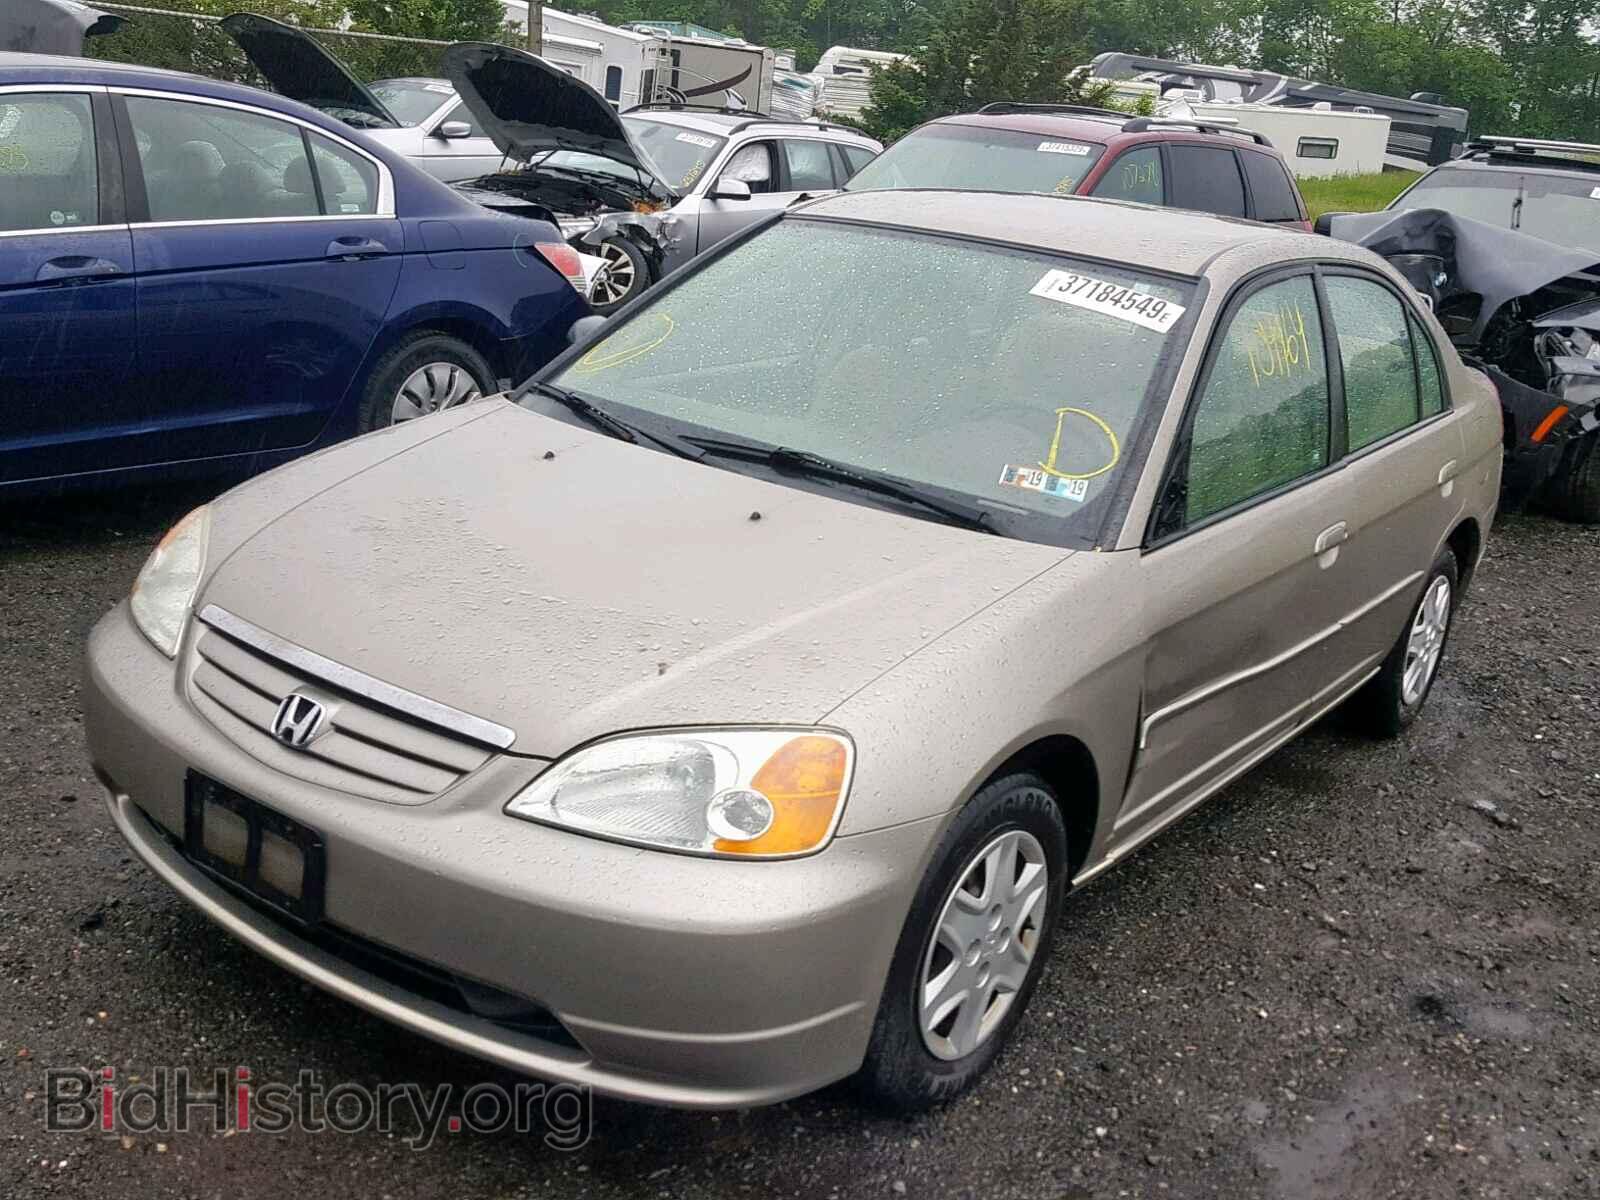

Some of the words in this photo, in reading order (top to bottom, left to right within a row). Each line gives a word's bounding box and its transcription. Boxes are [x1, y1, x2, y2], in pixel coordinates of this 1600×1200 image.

[1038, 407, 1120, 478] D
[1030, 471, 1043, 485] 19
[1072, 480, 1084, 495] 19
